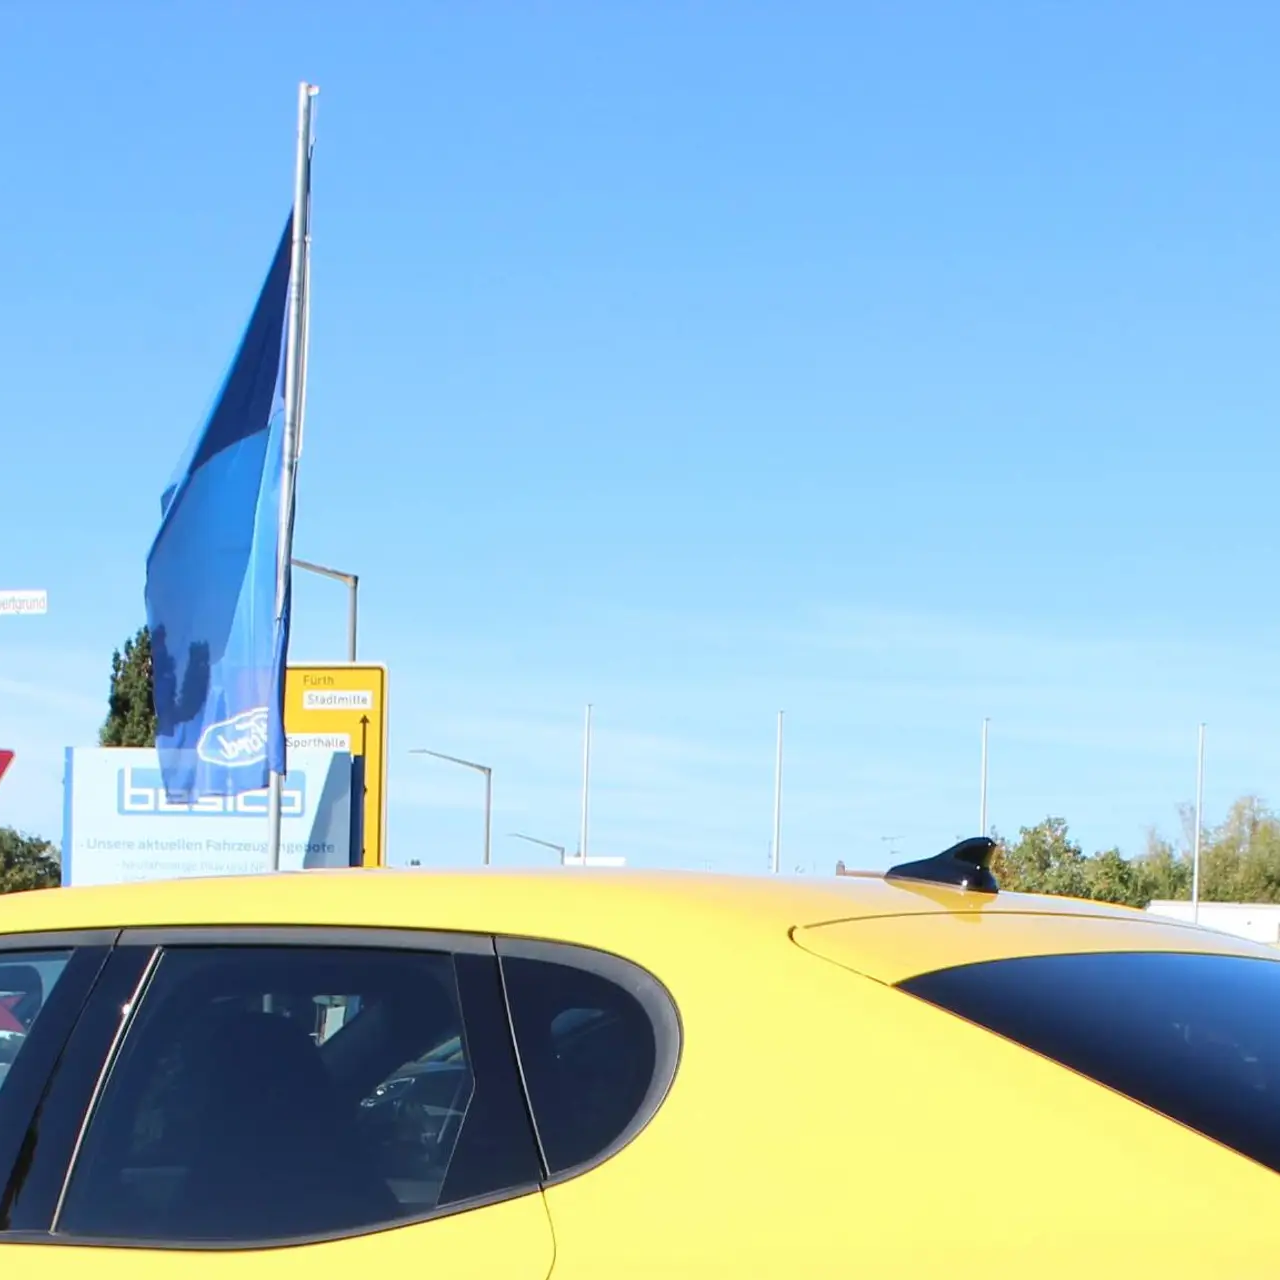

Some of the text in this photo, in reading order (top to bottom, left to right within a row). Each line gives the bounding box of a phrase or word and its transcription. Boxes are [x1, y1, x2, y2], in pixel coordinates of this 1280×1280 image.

[303, 675, 335, 686] Fürth
[308, 694, 368, 705] Stadtmitte
[86, 838, 134, 851] Unsere
[138, 839, 204, 852] aktuellen
